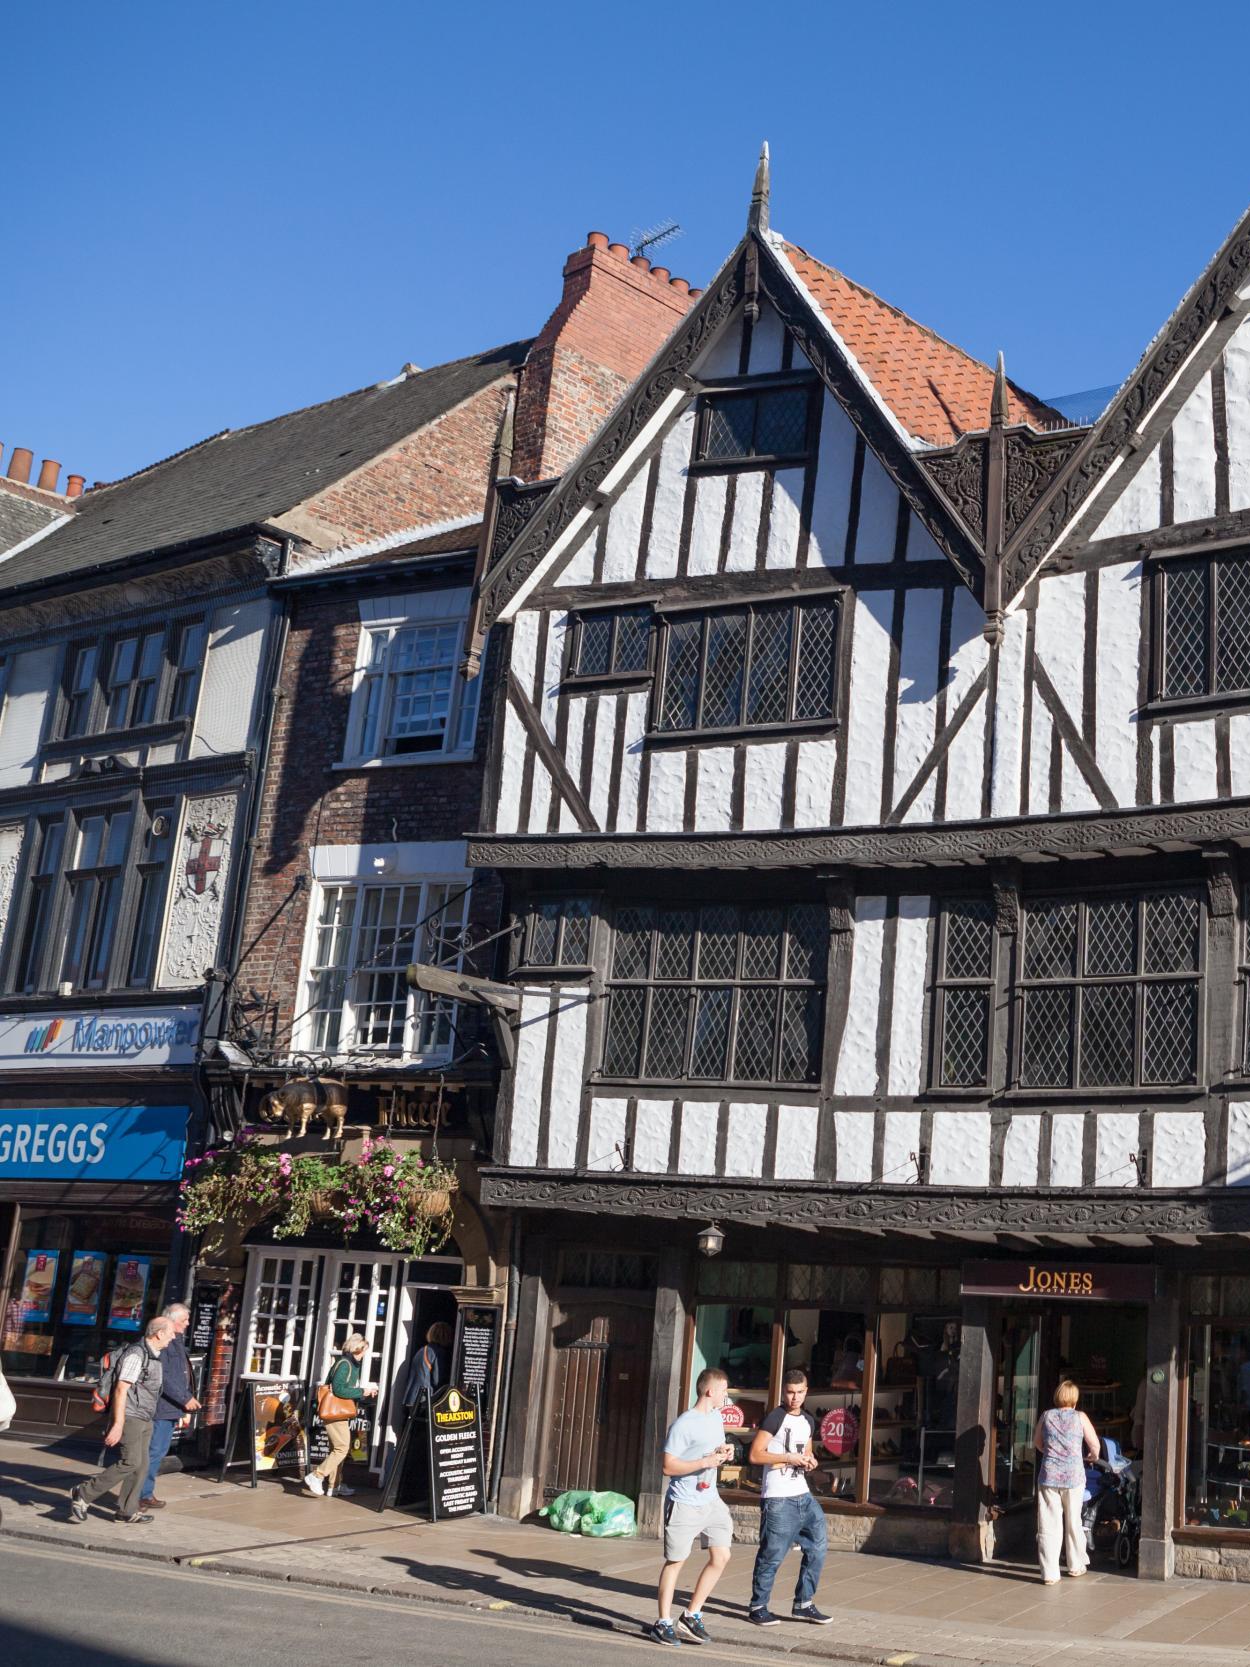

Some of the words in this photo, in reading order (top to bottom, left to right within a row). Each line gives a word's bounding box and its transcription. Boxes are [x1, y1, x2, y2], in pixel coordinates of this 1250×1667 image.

[73, 1016, 199, 1051] Manpower
[436, 1411, 474, 1423] THEAKSTON
[435, 1434, 458, 1443] GOLDEN
[459, 1431, 477, 1440] FLEECE
